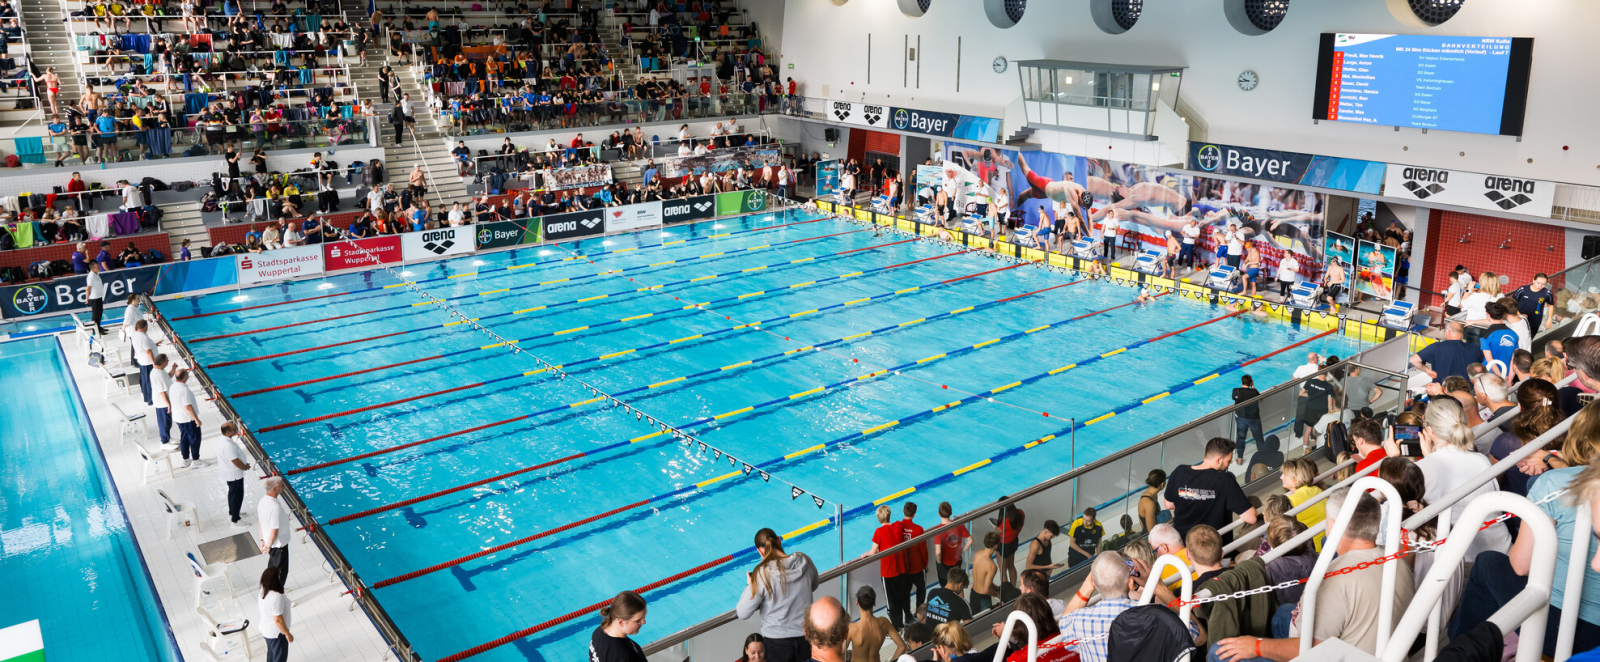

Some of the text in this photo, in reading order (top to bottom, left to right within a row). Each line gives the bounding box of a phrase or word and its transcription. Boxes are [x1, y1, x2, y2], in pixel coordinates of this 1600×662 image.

[834, 101, 851, 111] arena
[864, 105, 882, 114] arena
[911, 112, 948, 133] Bayer
[1226, 150, 1291, 176] Bayer
[1403, 167, 1449, 183] arena
[1484, 175, 1536, 194] arena
[664, 204, 690, 216] arena
[547, 220, 576, 234] arena
[422, 230, 455, 242] arena
[494, 229, 518, 240] Bayer
[258, 254, 318, 268] Stadtsparkasse
[258, 265, 301, 277] Wuppertal
[16, 296, 45, 304] BAYER
